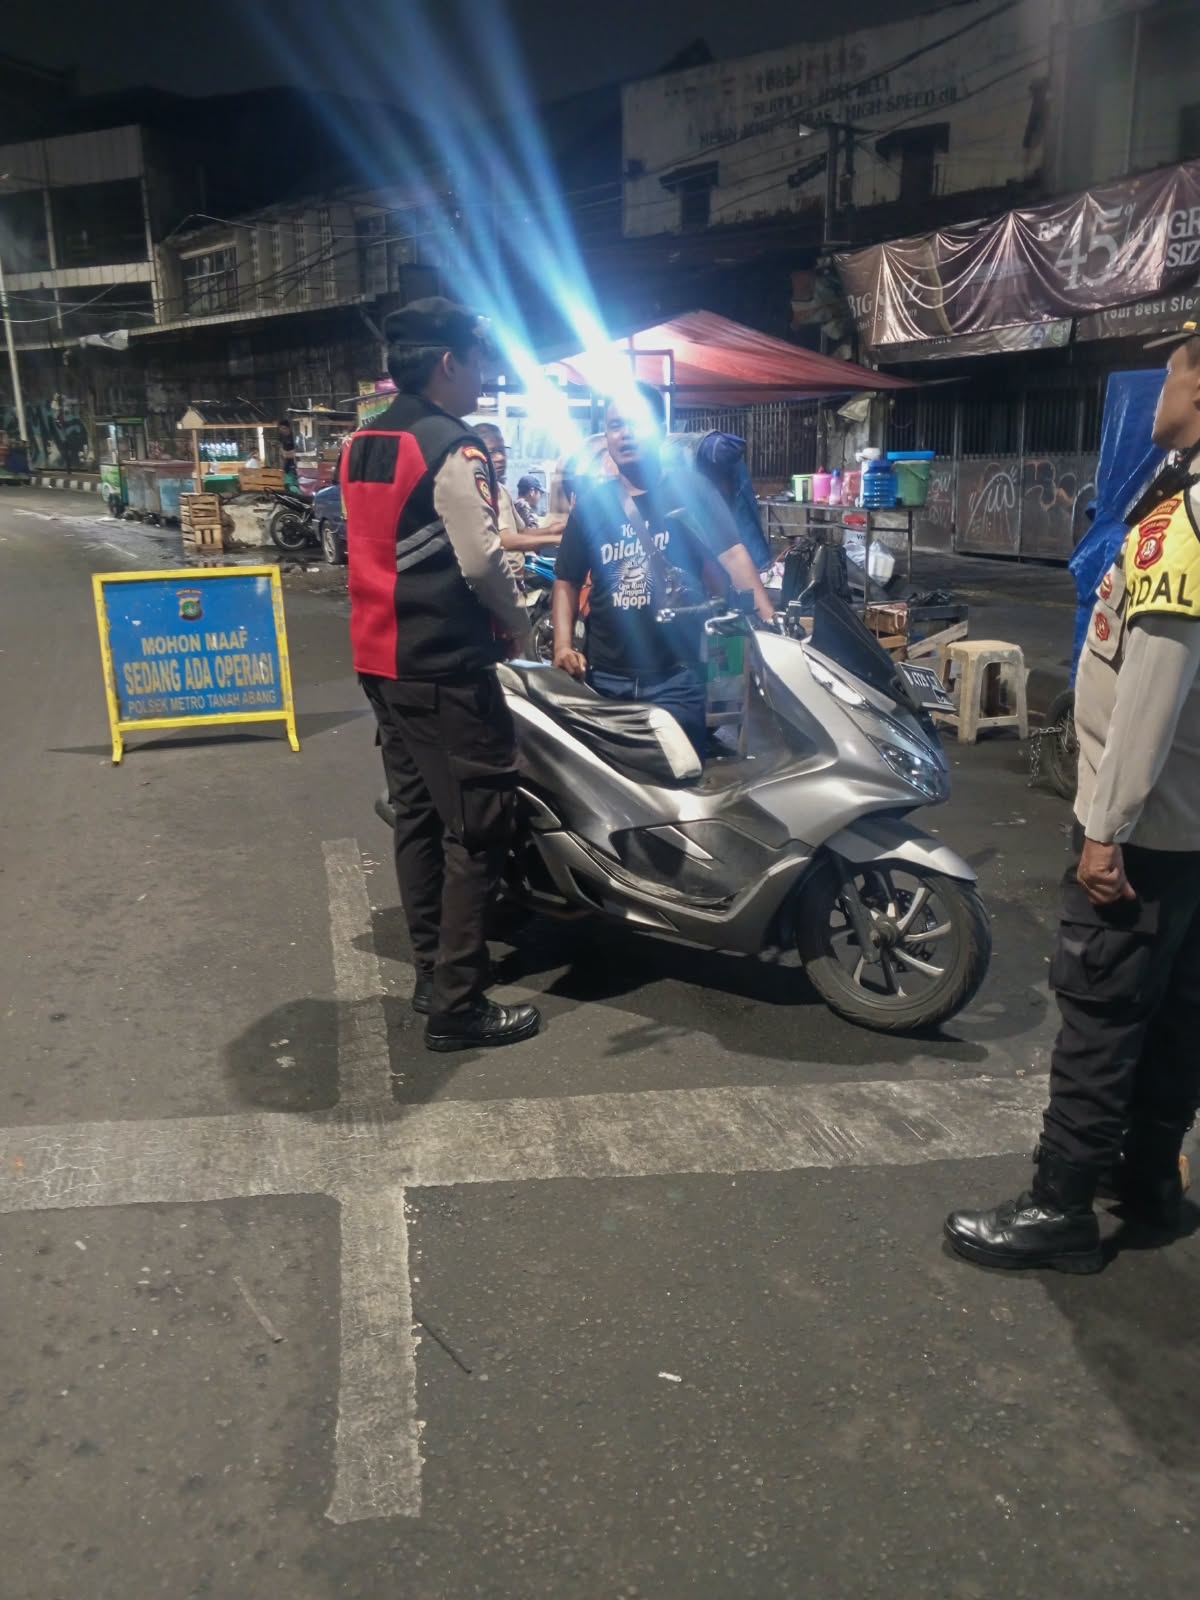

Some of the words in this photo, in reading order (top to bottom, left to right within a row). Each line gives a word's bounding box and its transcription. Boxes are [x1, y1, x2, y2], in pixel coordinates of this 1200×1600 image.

[1135, 300, 1167, 317] Best
[612, 591, 652, 610] Ngopi
[141, 633, 201, 656] MOHON
[205, 630, 248, 651] MAAF
[124, 658, 181, 695] SEDANG
[185, 657, 214, 691] ADA
[215, 653, 274, 689] OPERASI
[128, 699, 168, 714] POLSEK
[171, 695, 205, 712] METRO
[207, 693, 241, 709] TANAH
[242, 690, 276, 705] ABANG
